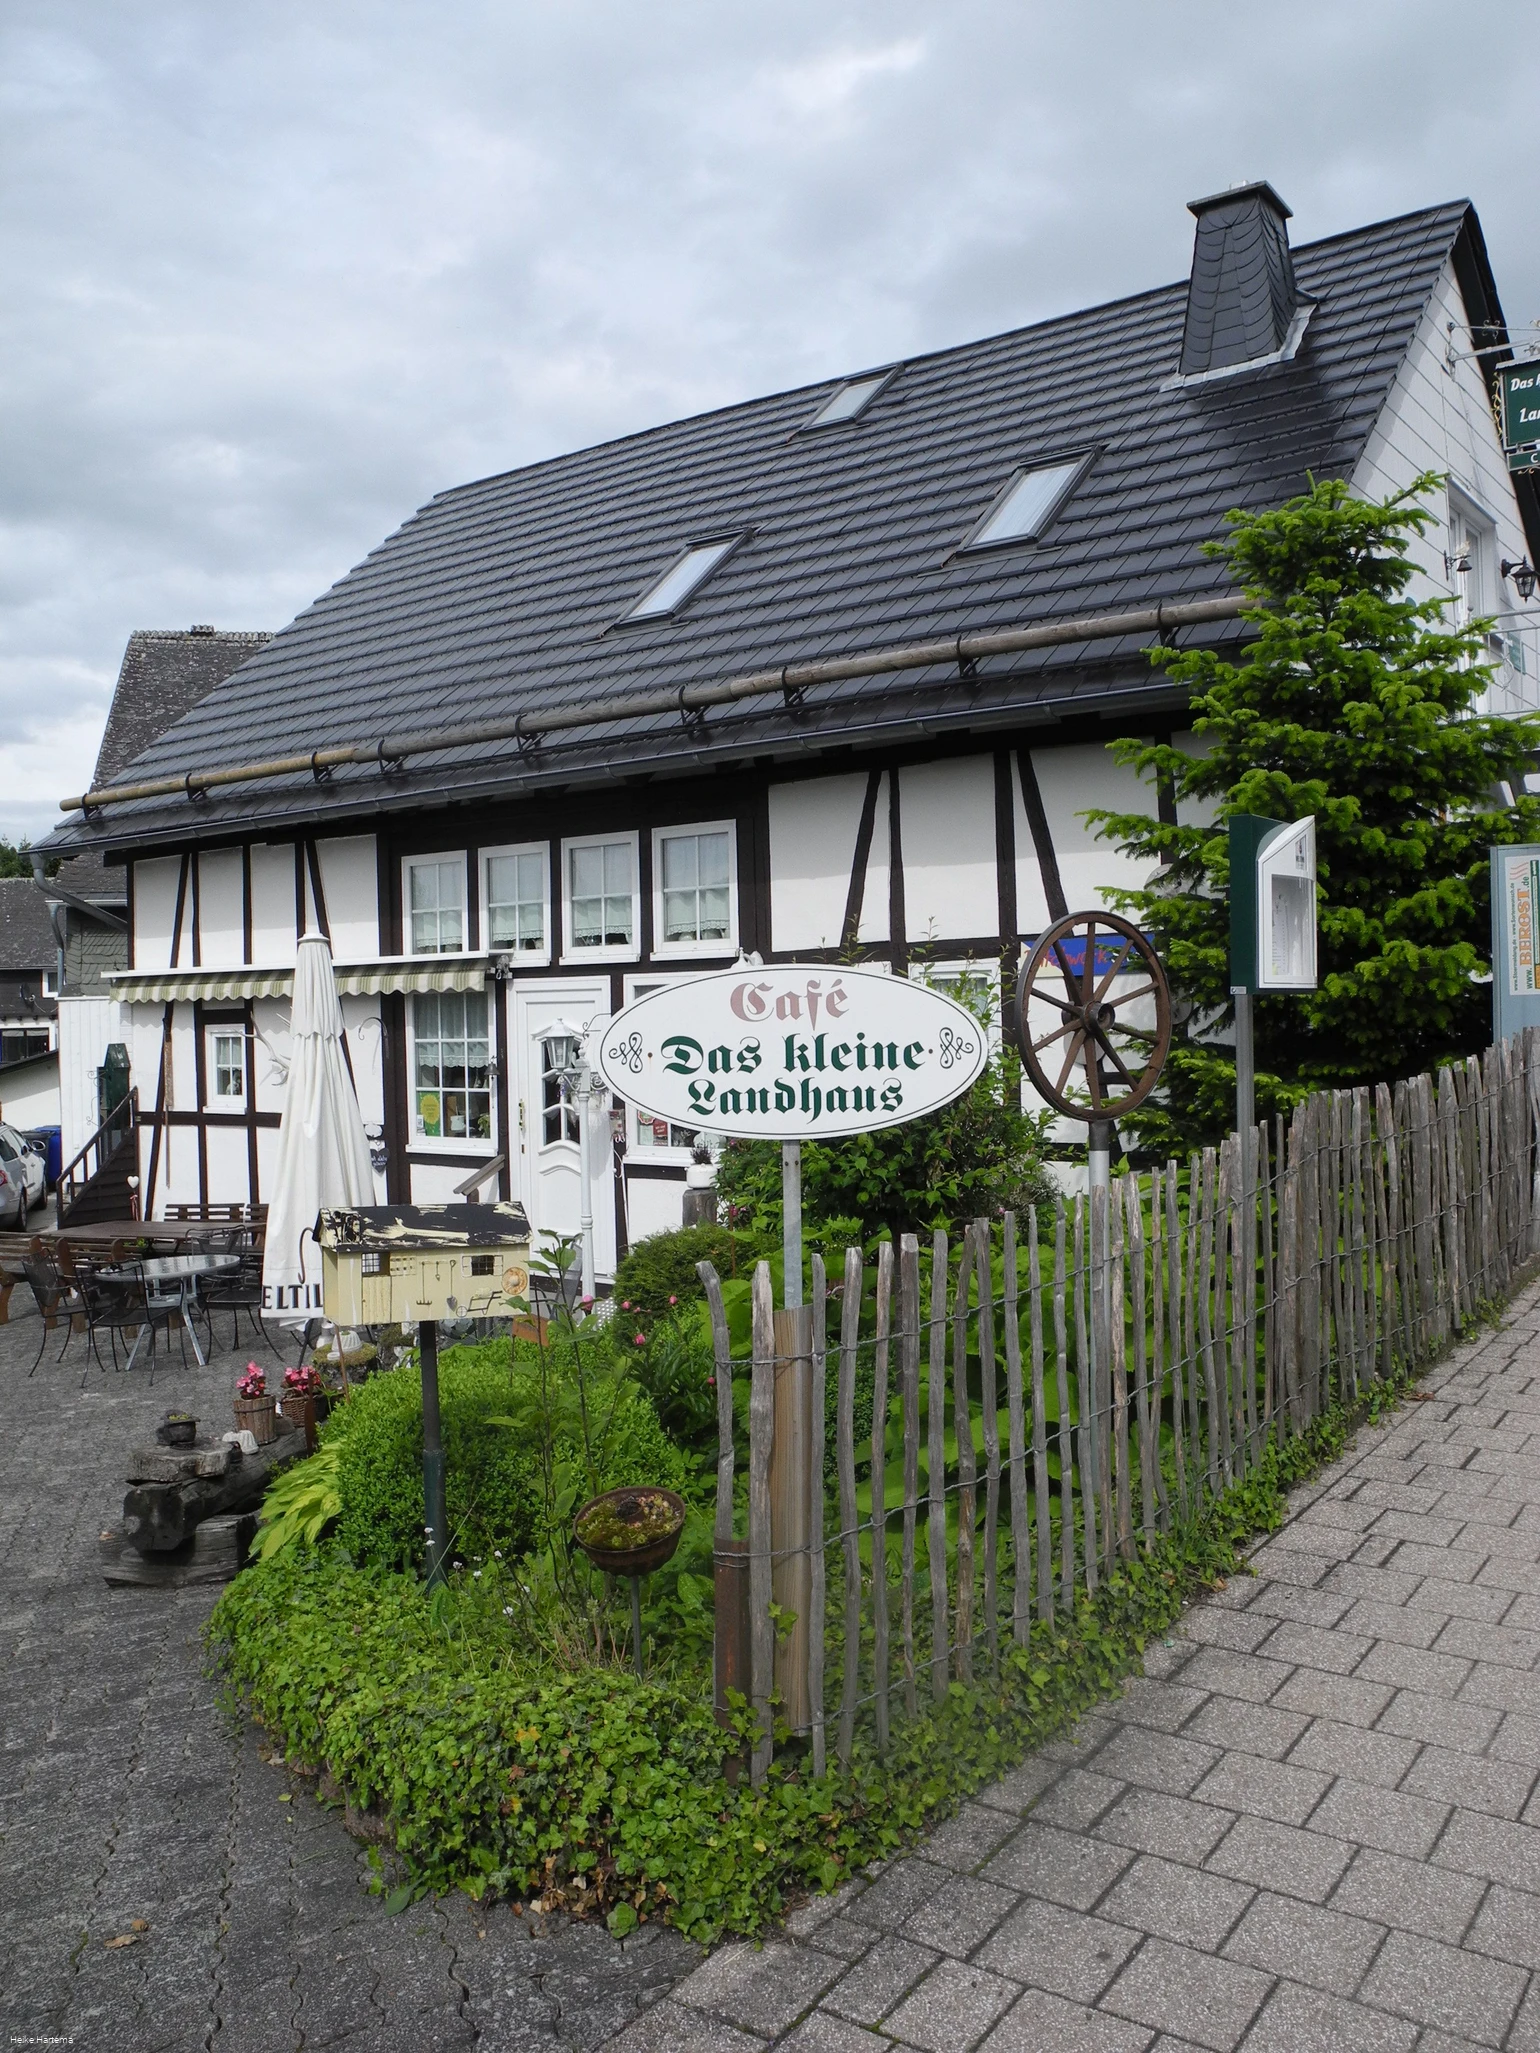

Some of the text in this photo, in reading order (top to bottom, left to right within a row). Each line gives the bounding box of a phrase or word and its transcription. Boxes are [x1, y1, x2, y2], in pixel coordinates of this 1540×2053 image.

[1510, 378, 1533, 391] Das
[730, 978, 850, 1031] Café
[661, 1031, 925, 1075] Das kleine
[687, 1076, 904, 1125] Landhaus
